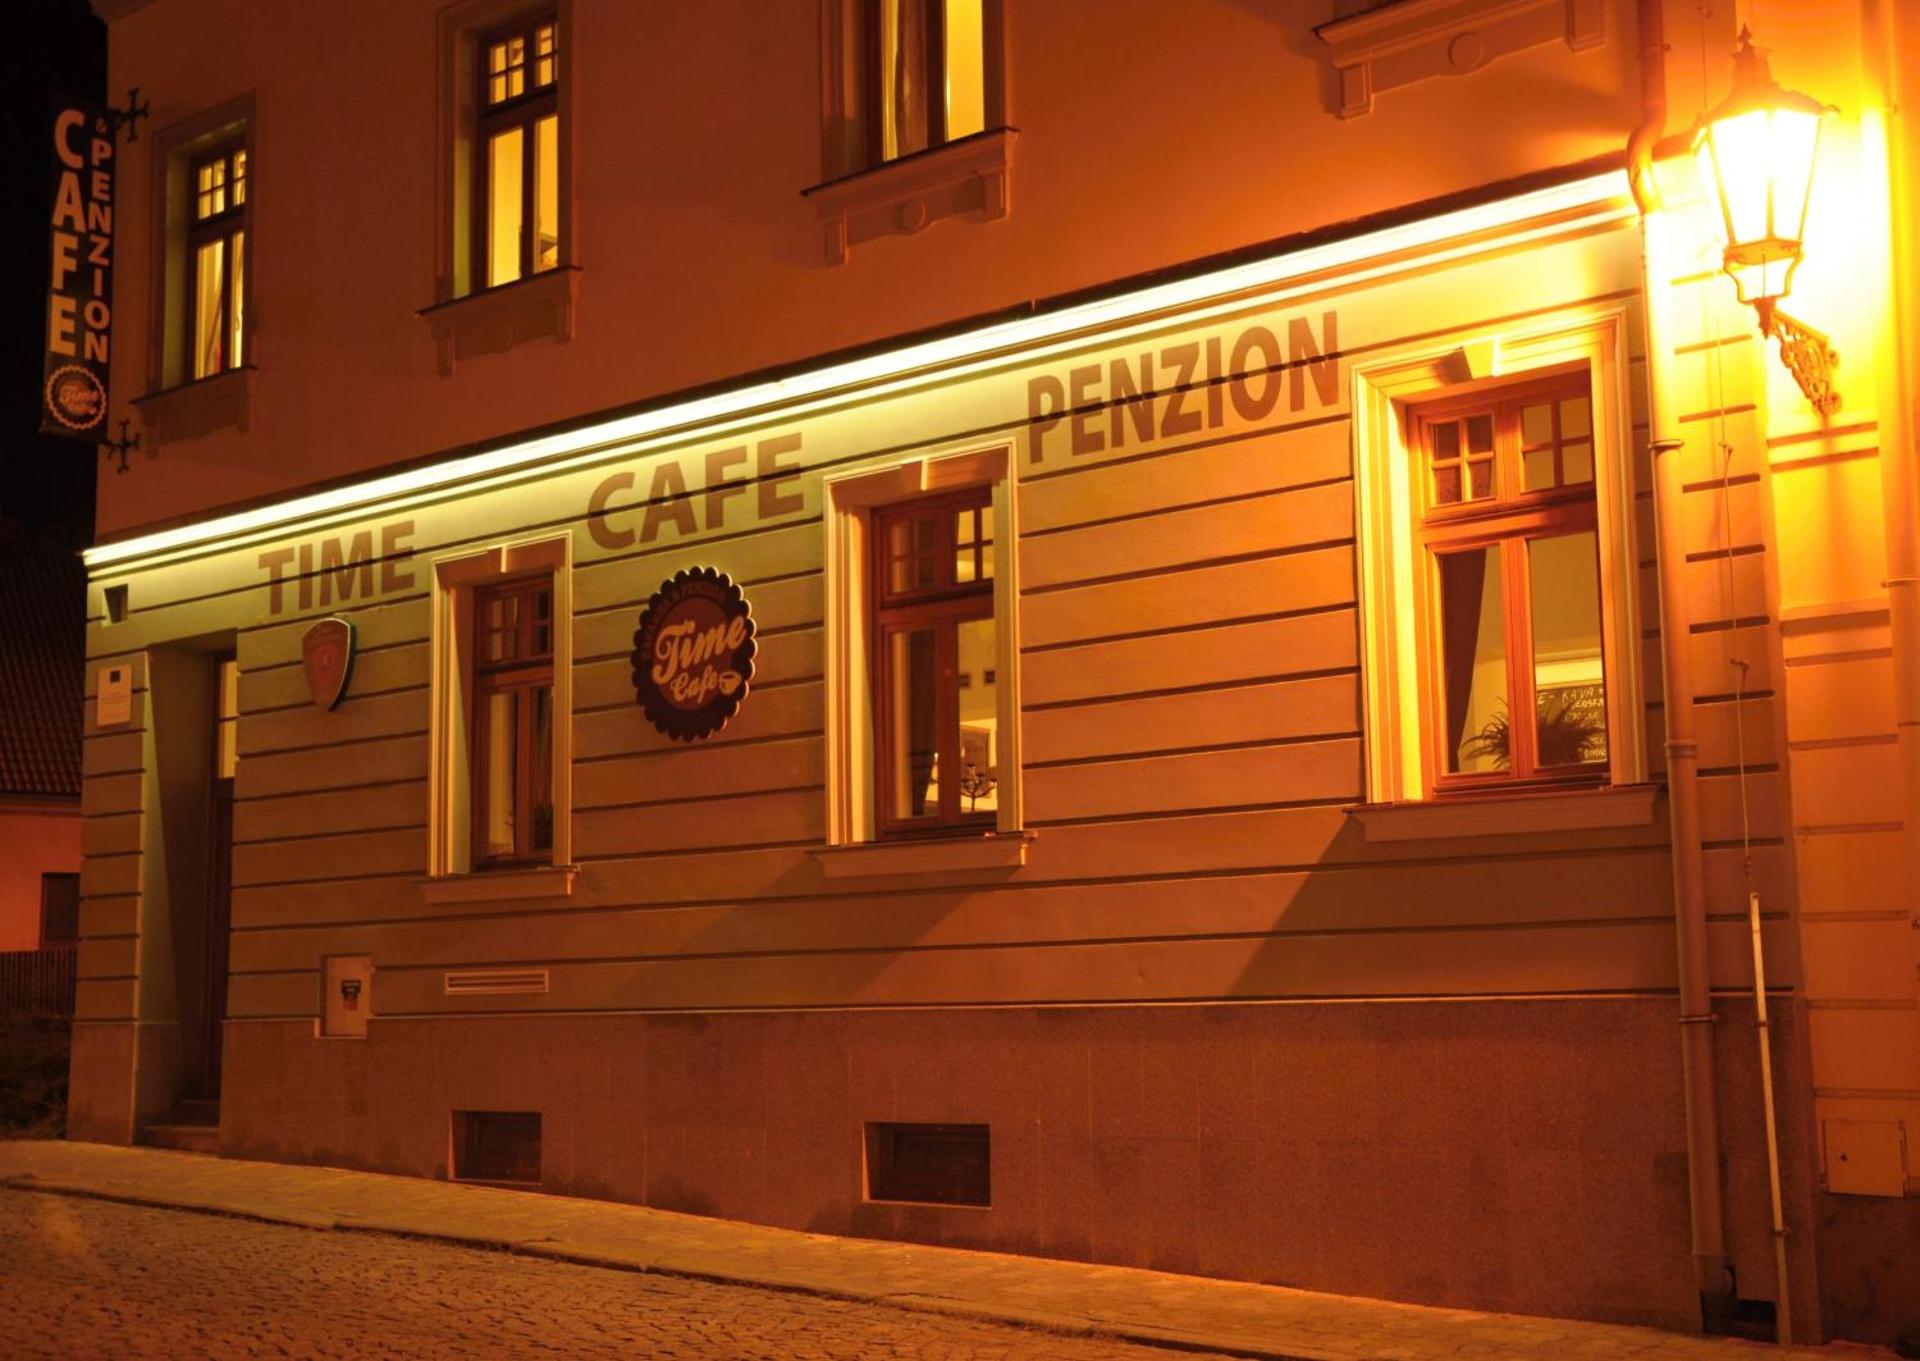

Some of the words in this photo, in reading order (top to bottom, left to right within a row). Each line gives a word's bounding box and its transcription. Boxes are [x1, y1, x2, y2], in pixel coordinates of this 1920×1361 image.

[50, 109, 86, 358] CAFE
[83, 138, 113, 364] PENZION
[1027, 310, 1340, 464] PENZION
[259, 520, 417, 616] TIME
[587, 433, 805, 550] CAFE
[652, 616, 747, 685] Time
[670, 665, 719, 704] Cafe
